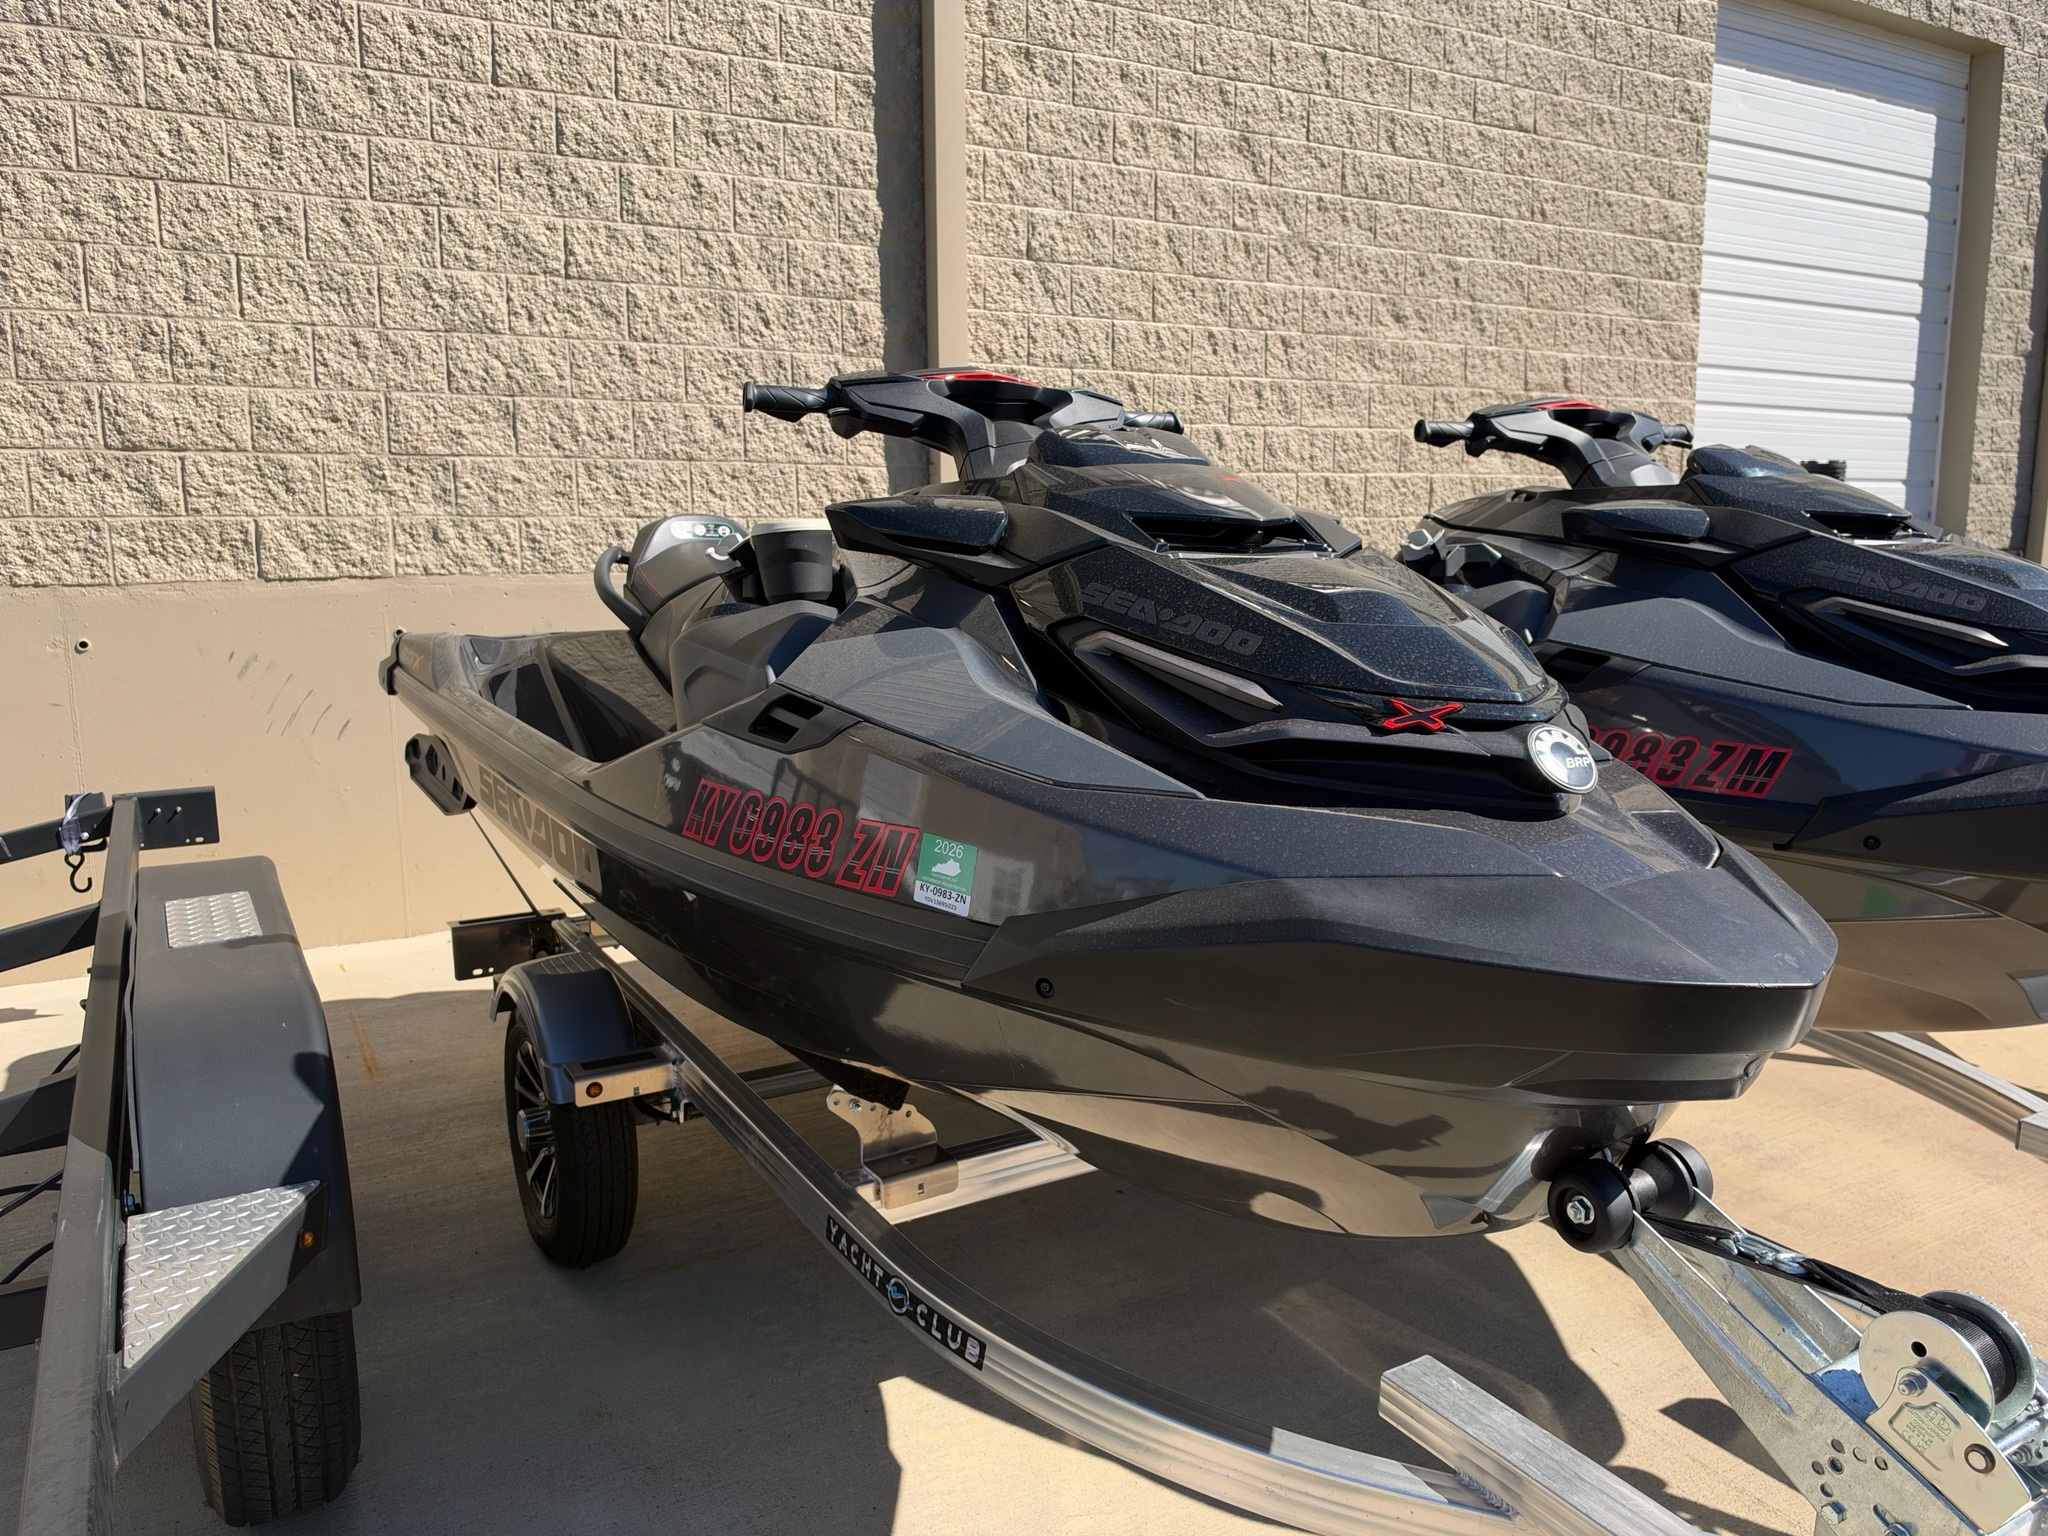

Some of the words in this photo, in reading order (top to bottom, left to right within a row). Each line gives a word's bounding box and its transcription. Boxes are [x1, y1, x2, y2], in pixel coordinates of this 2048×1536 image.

[1565, 756, 1591, 769] BRP
[1686, 740, 1794, 798] ZM
[835, 818, 921, 898] ZN
[934, 839, 964, 859] 2026
[919, 883, 967, 904] KY-0983-ZN
[828, 1219, 884, 1288] YACHT
[916, 1303, 981, 1364] CLUB
